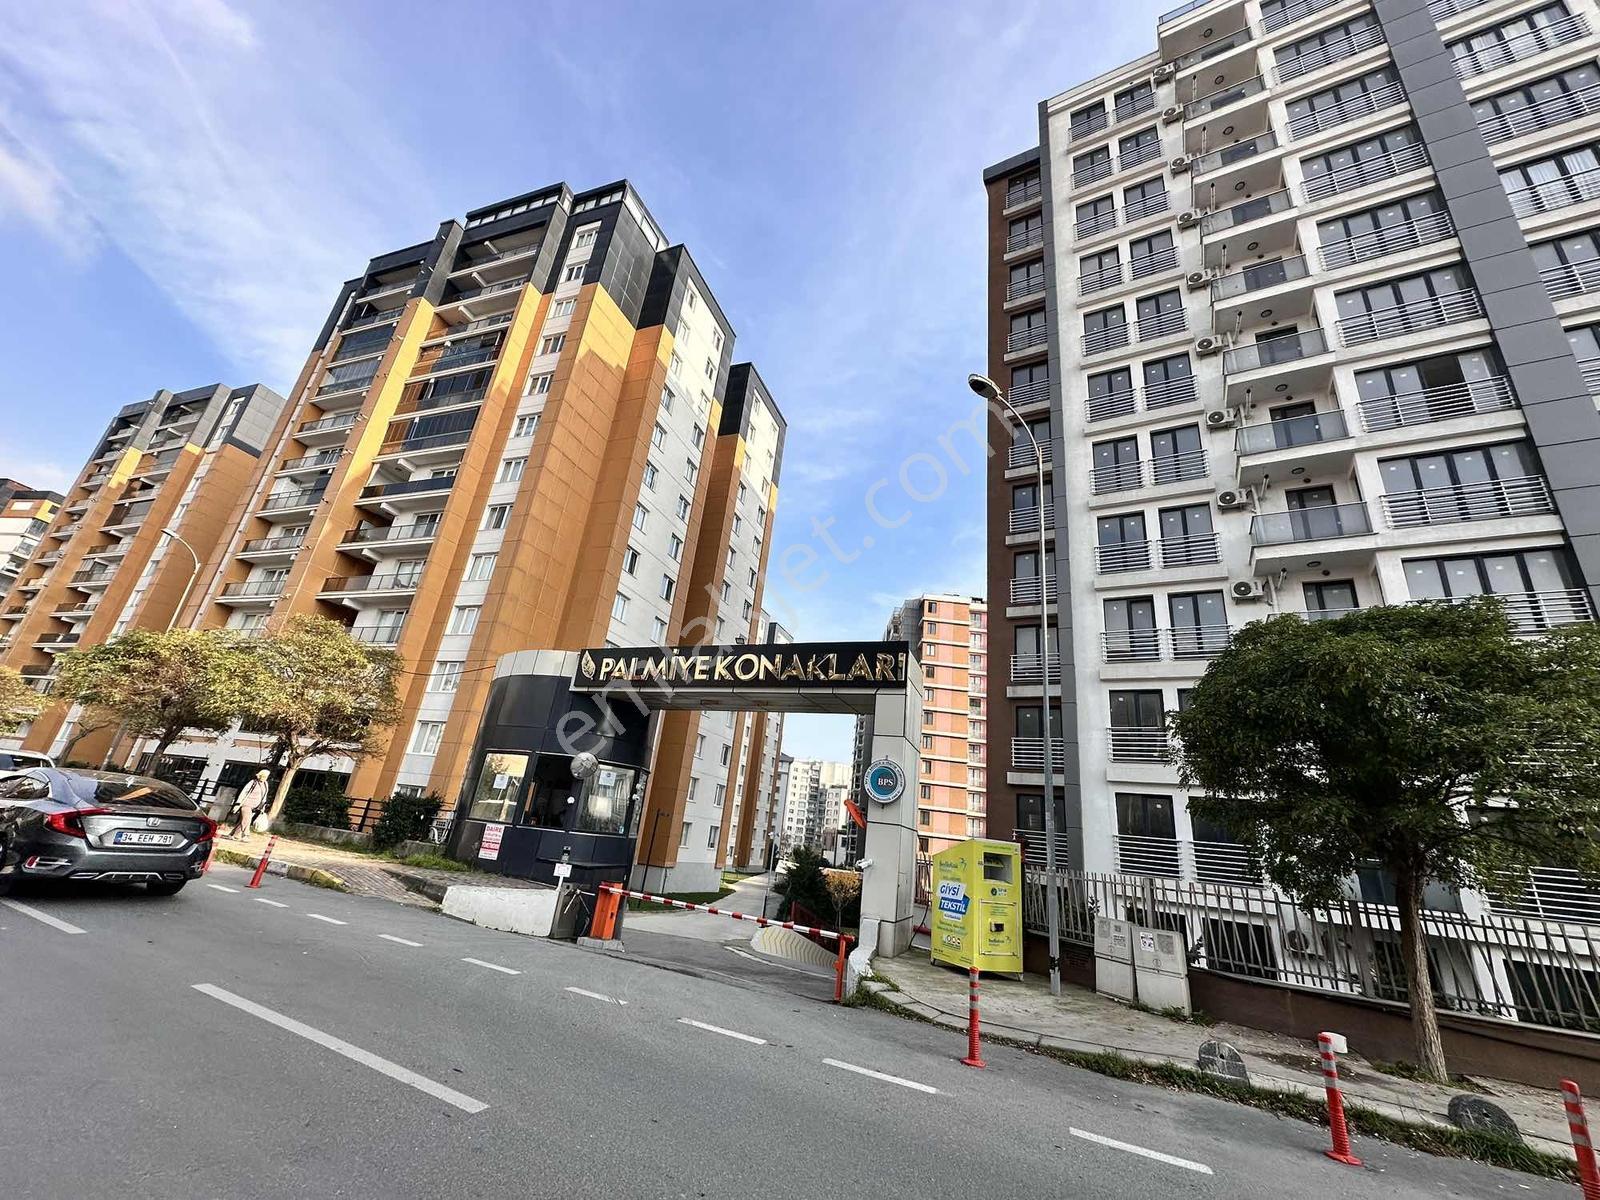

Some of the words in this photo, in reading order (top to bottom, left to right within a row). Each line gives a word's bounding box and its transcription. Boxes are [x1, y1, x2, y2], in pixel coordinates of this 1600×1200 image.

[599, 648, 712, 681] PALMİYE
[713, 653, 906, 681] KONAKLARI
[878, 777, 894, 787] BPS
[122, 833, 133, 842] 34
[157, 835, 172, 844] 791
[940, 883, 961, 897] GİYSİ
[940, 900, 966, 912] TEKSTİL
